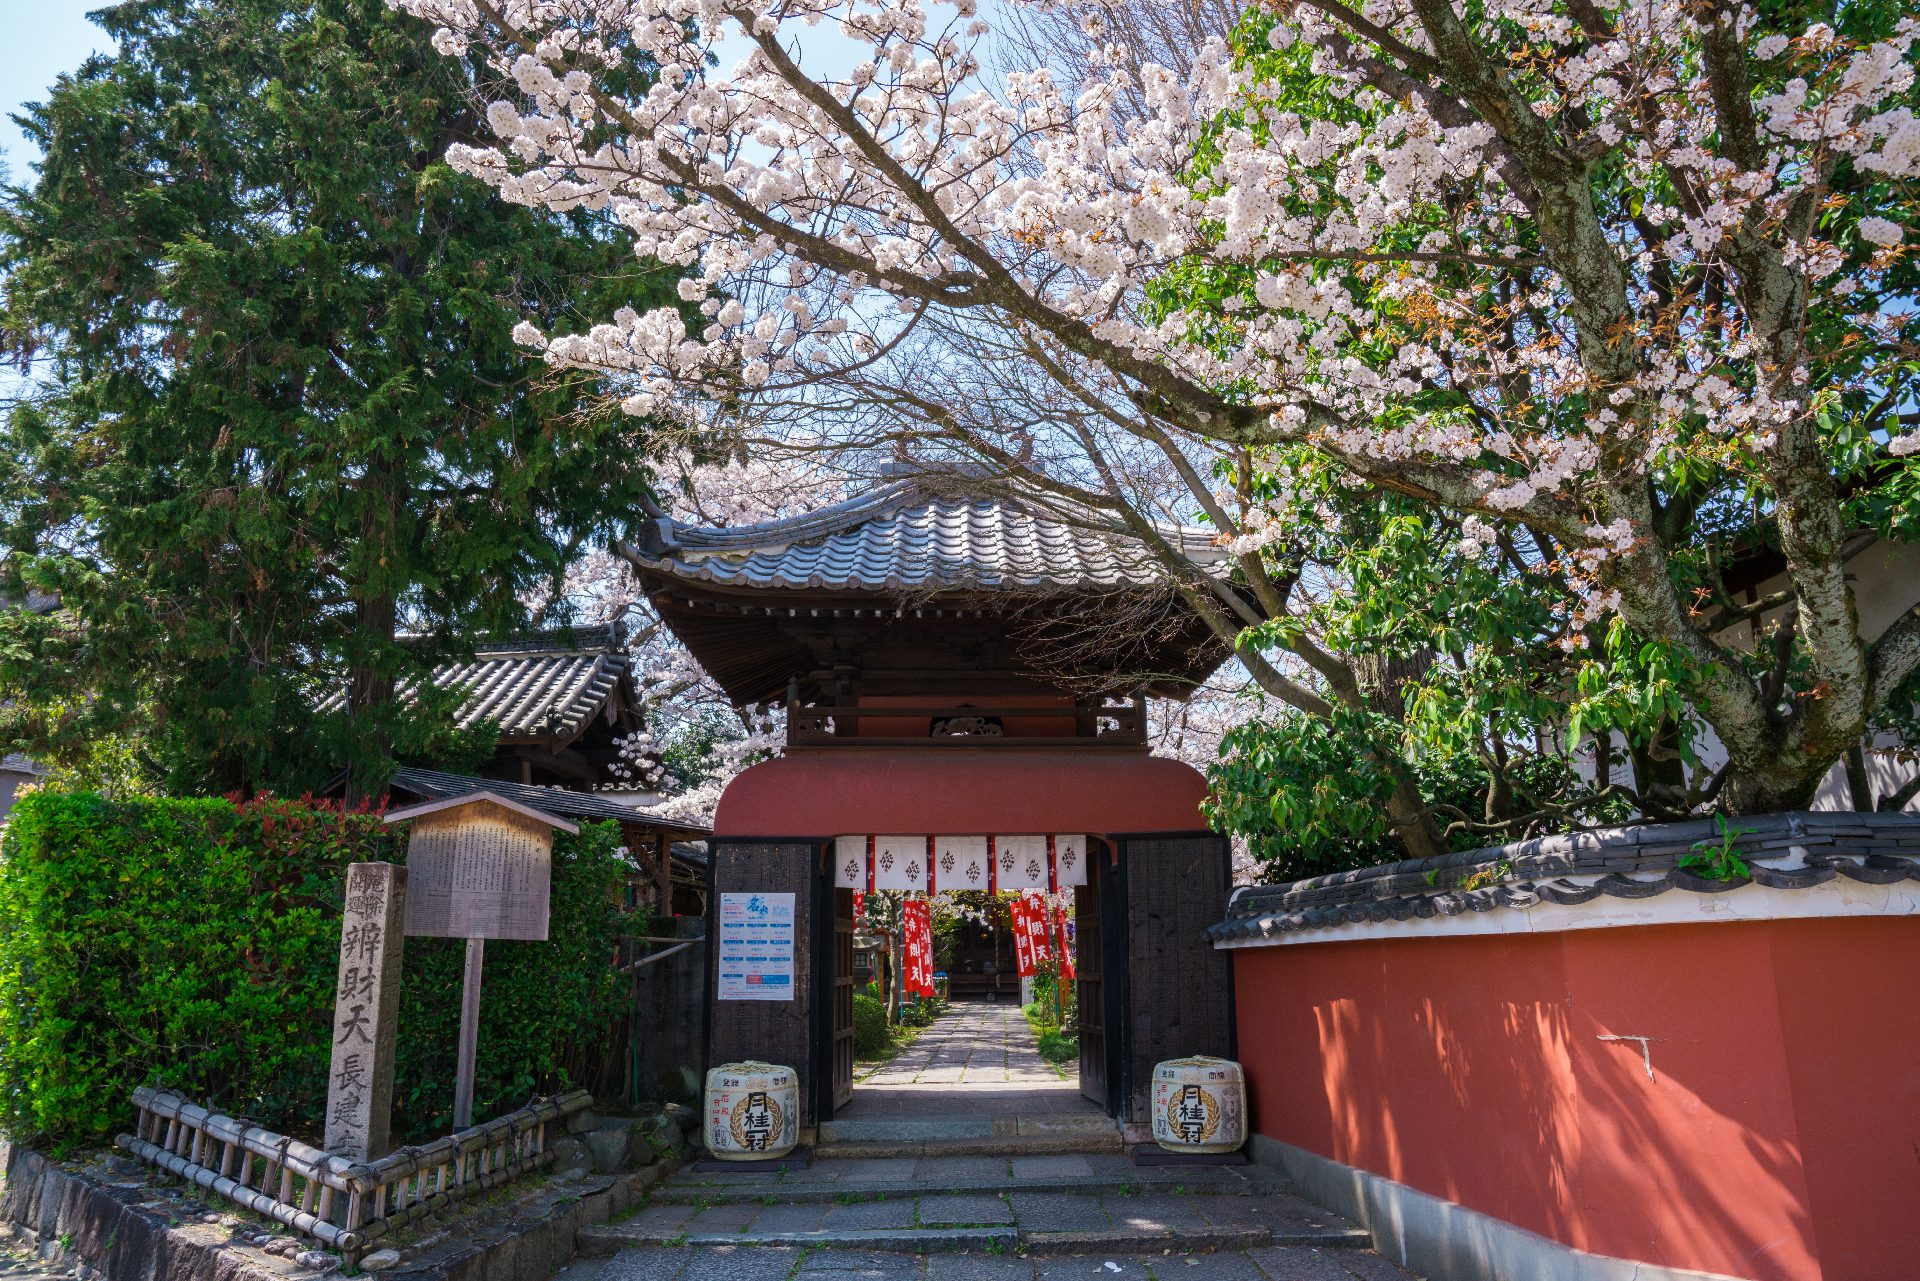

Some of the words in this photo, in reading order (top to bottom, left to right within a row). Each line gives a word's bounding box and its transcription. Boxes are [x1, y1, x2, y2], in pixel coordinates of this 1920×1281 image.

[743, 1091, 771, 1151] 月桂冠
[1179, 1084, 1206, 1144] 月桂冠
